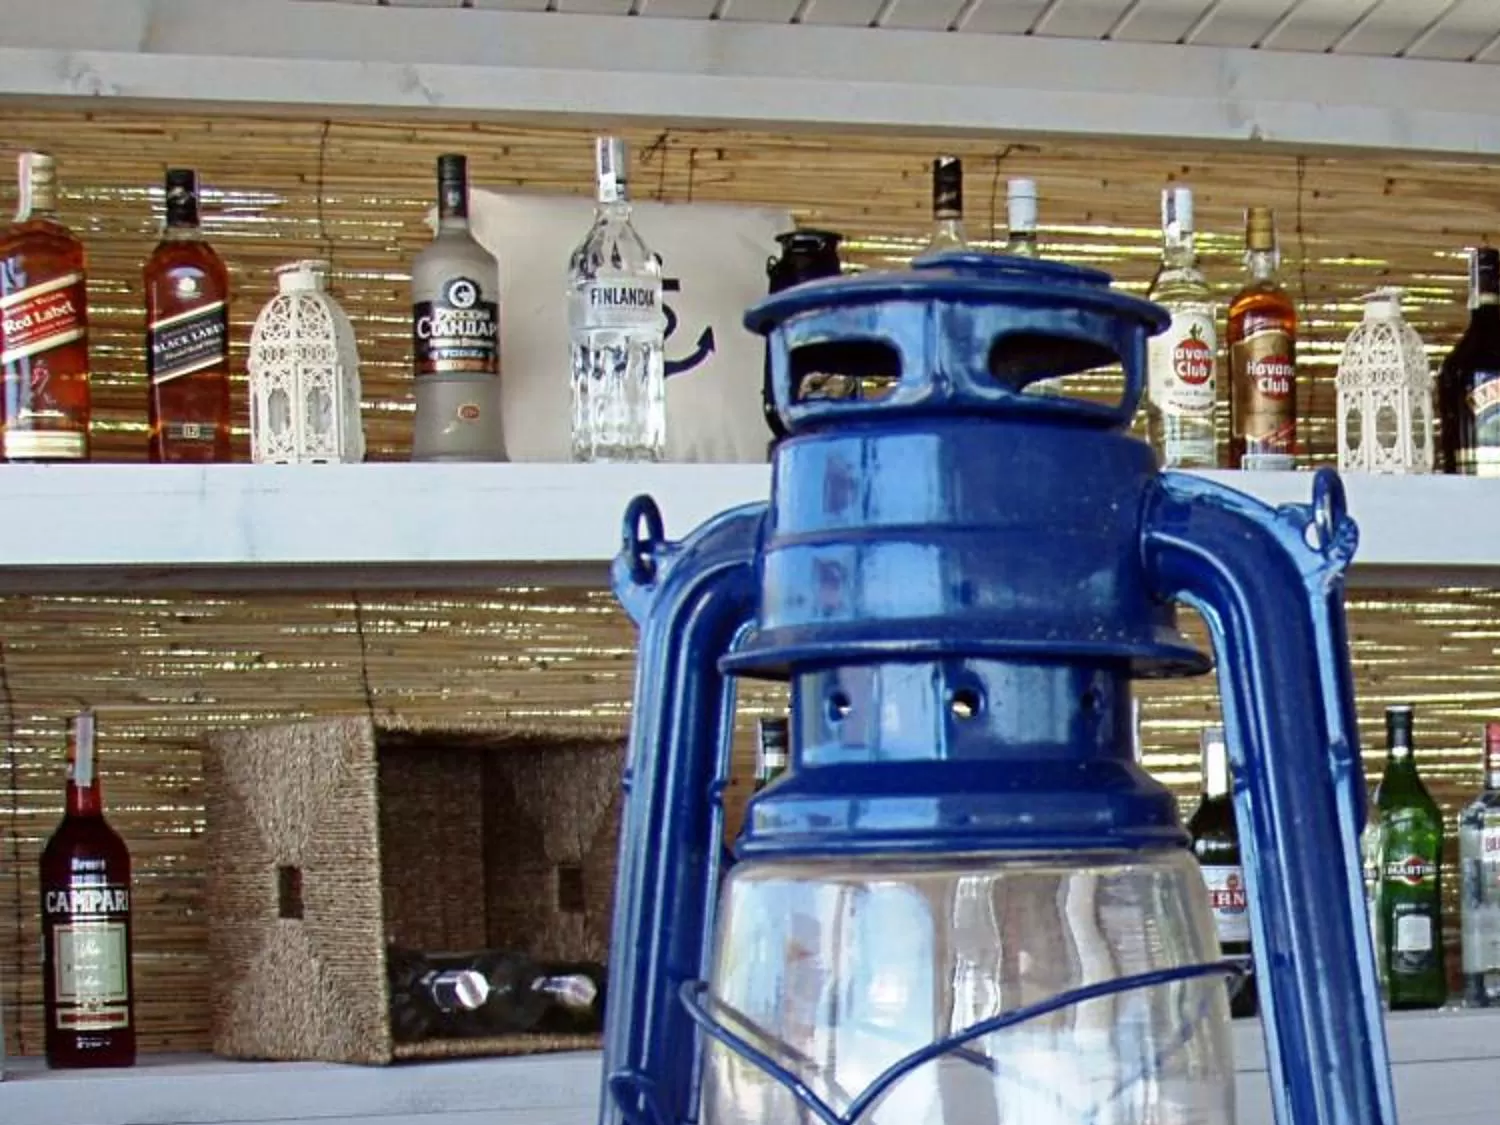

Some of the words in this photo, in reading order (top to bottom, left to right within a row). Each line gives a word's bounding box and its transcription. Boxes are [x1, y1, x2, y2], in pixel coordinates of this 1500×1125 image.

[2, 314, 33, 335] Red
[33, 300, 77, 324] Label
[1177, 360, 1208, 377] Club
[1257, 377, 1290, 394] Club
[46, 889, 129, 914] CAMPARI
